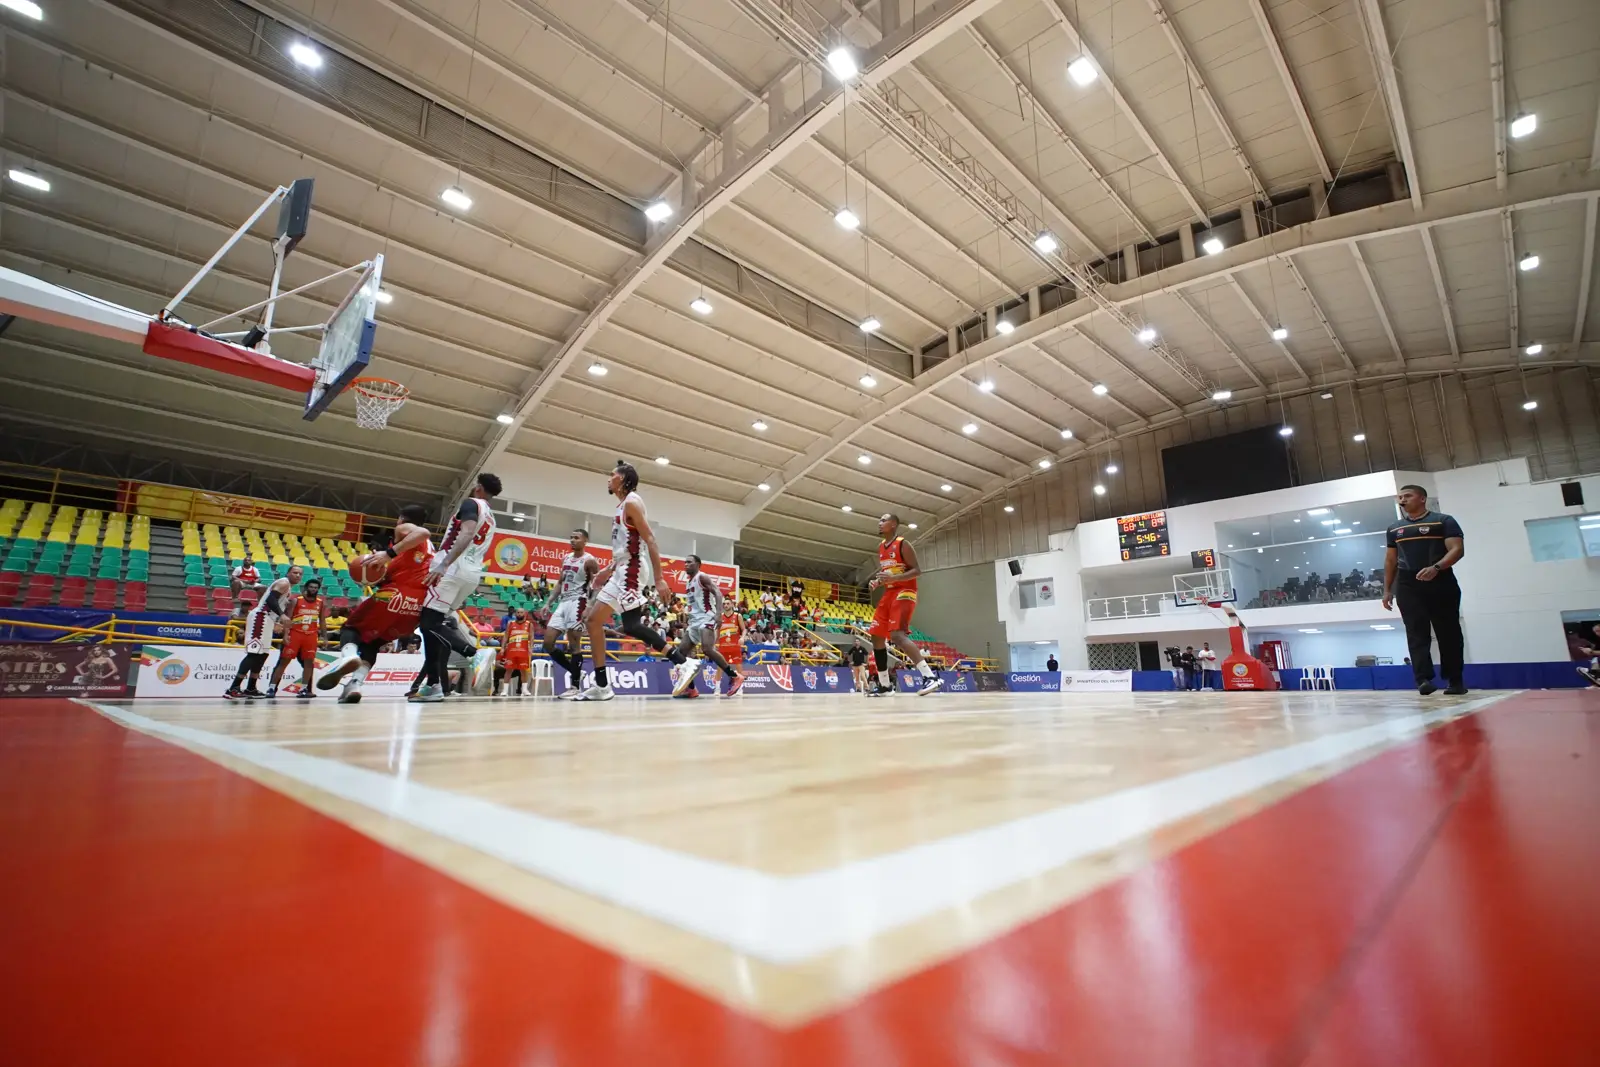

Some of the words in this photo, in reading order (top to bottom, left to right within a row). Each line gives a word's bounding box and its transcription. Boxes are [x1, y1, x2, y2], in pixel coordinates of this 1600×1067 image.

[1123, 522, 1135, 532] 68
[1136, 532, 1156, 544] 5:46
[1161, 546, 1167, 555] 2
[1197, 549, 1211, 557] 5:46
[1123, 551, 1129, 560] 0
[1205, 555, 1213, 567] 9
[157, 626, 202, 635] COLOMBIA
[195, 663, 237, 671] Alcaldía
[1011, 673, 1041, 682] Gestión
[1041, 682, 1058, 690] salud
